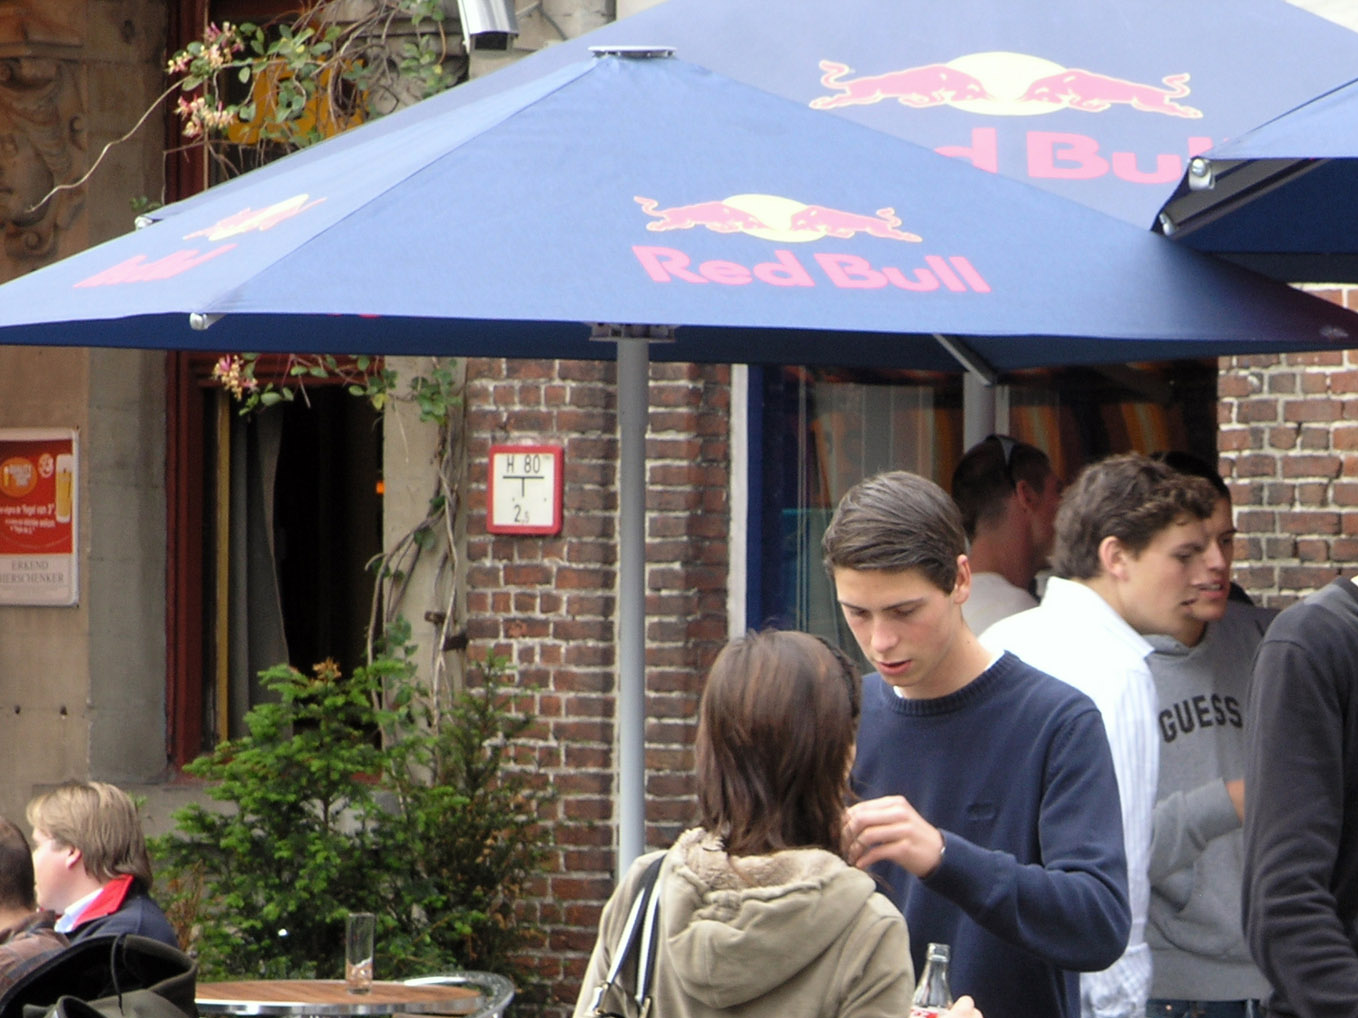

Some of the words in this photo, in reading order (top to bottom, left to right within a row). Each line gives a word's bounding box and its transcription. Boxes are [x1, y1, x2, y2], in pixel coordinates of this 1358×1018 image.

[1026, 130, 1213, 184] Bu
[631, 245, 816, 288] Red
[813, 252, 992, 293] Bull
[506, 454, 515, 473] H
[524, 454, 541, 474] 80
[1158, 693, 1244, 744] GUESS
